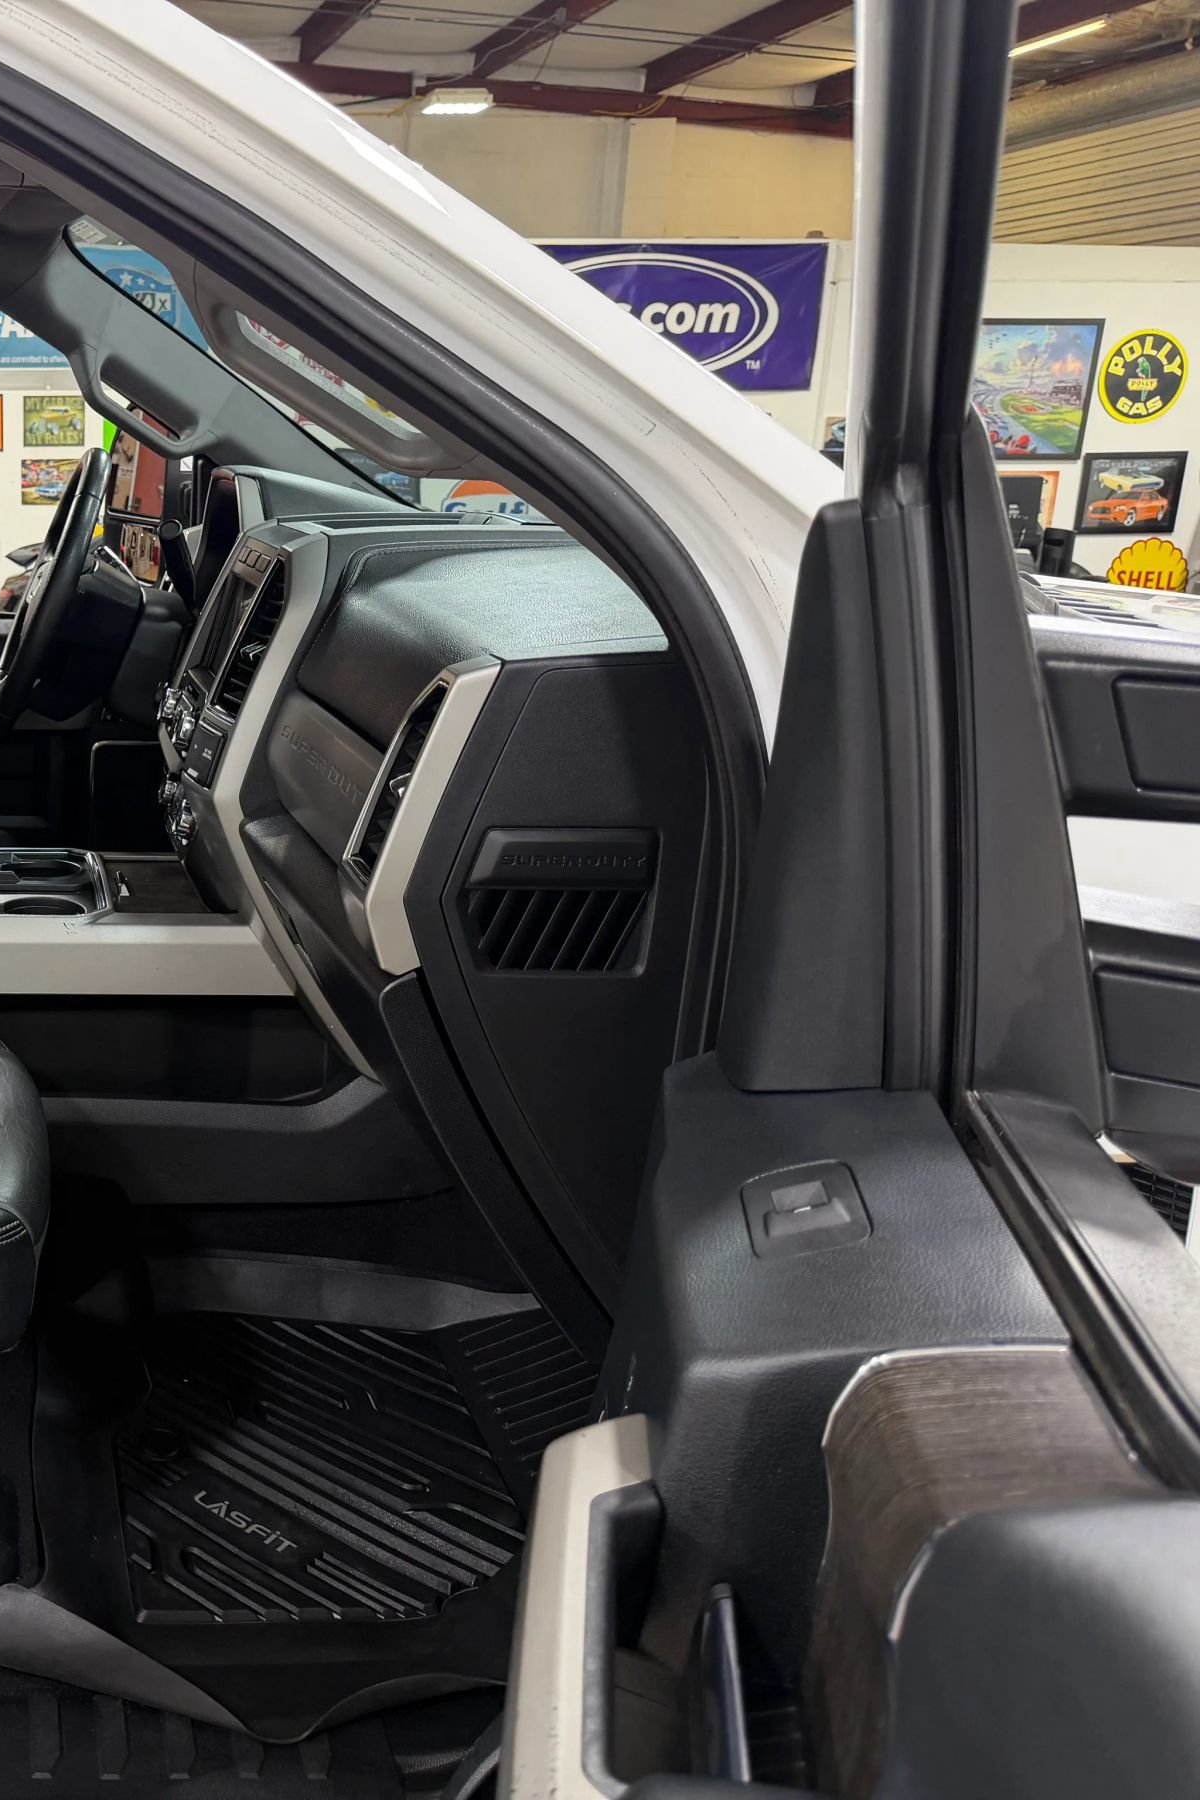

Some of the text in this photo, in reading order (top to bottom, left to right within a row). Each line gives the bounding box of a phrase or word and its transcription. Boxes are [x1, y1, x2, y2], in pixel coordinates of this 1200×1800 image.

[745, 360, 761, 370] TM
[1108, 336, 1182, 376] POLLY
[1116, 396, 1163, 415] GAS
[1116, 570, 1176, 590] SHELL
[194, 1490, 297, 1553] LASFIT
